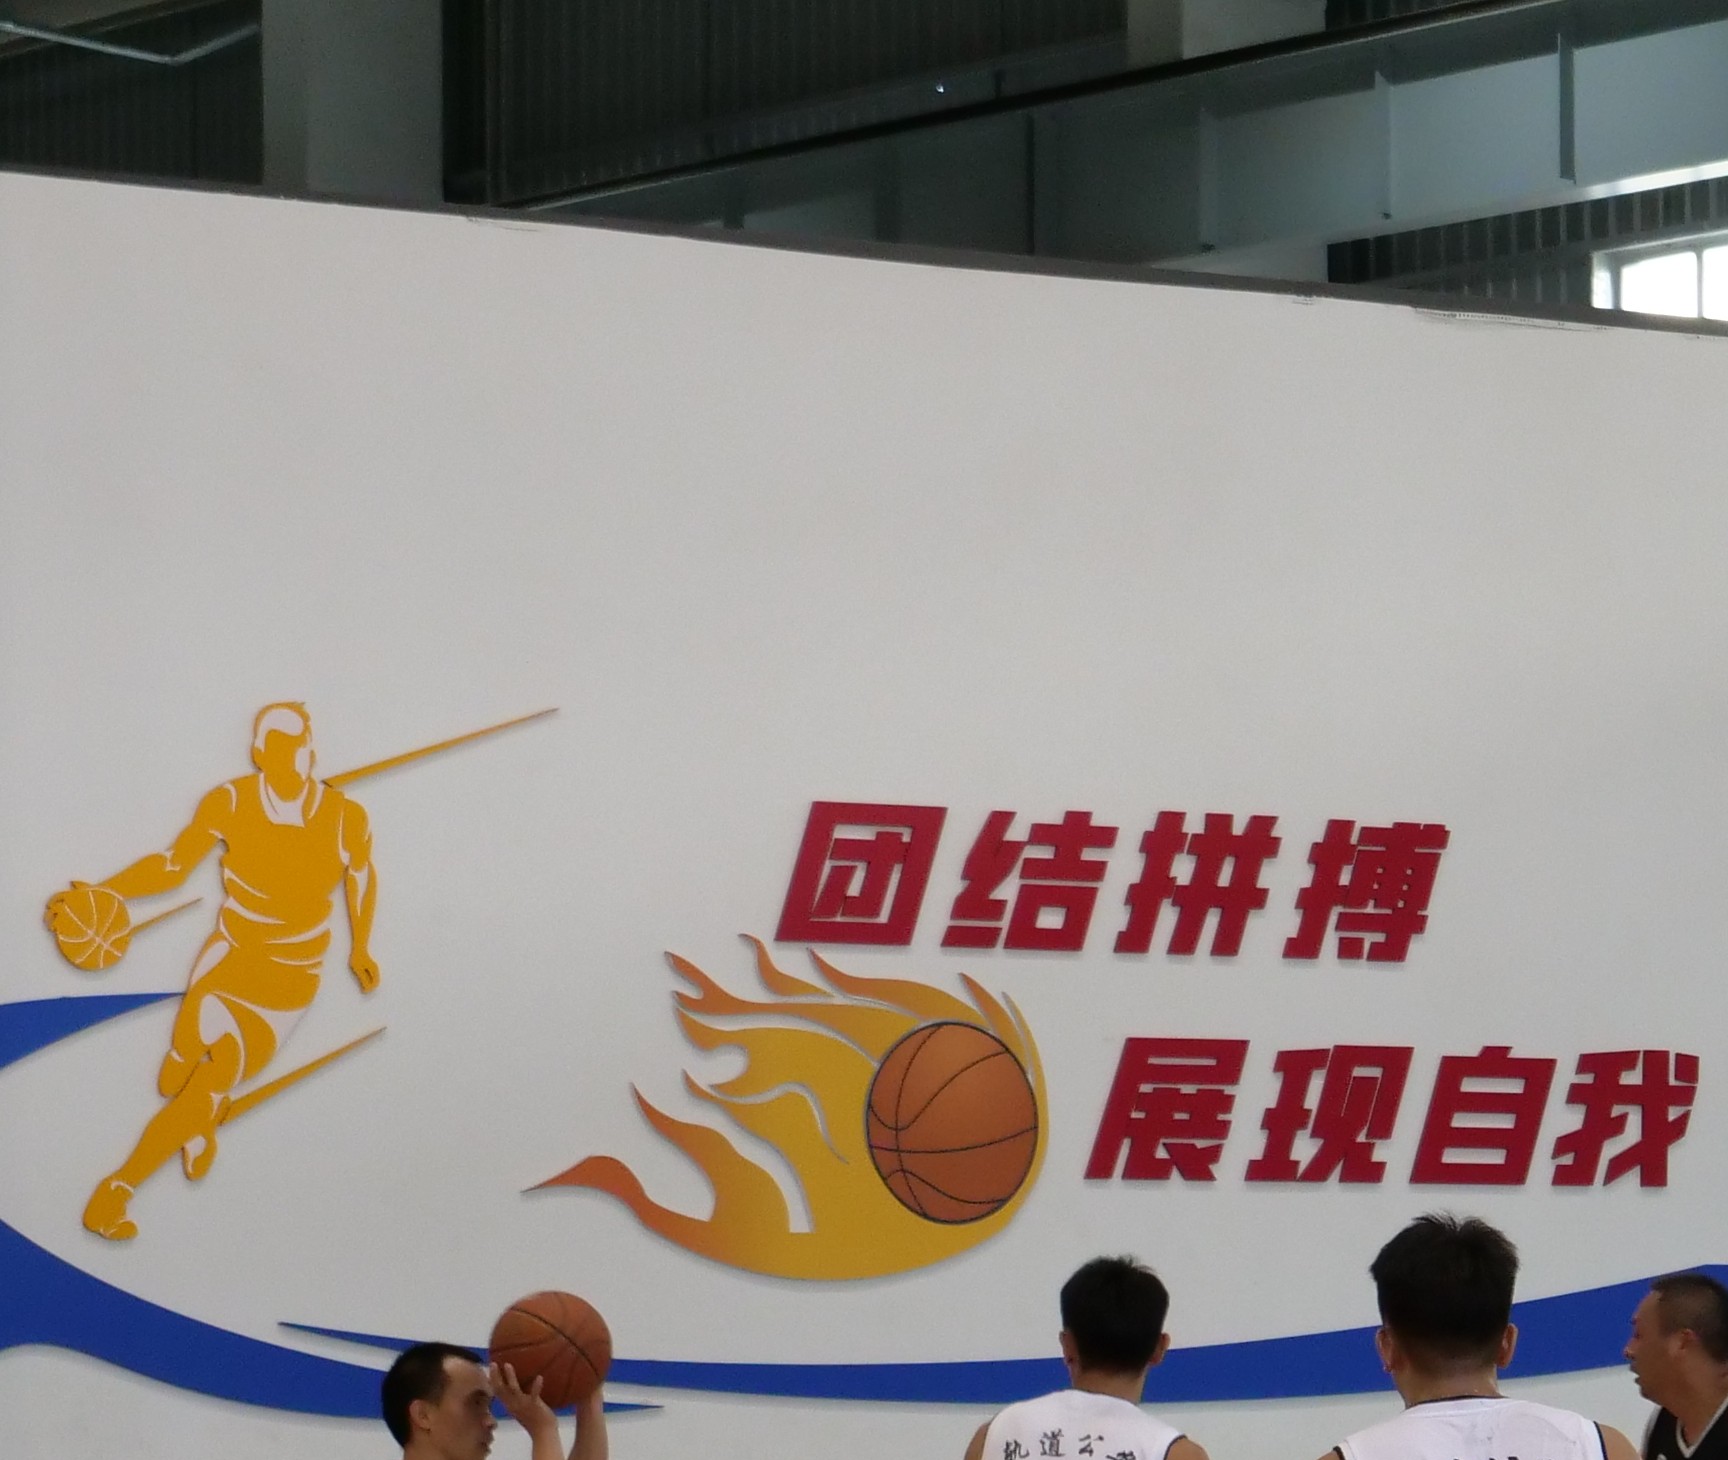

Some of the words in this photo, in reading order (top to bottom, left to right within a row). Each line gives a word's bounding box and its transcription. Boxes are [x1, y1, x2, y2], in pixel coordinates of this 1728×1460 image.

[776, 802, 1446, 963] 团结拼搏
[1088, 1038, 1696, 1185] 展现自我
